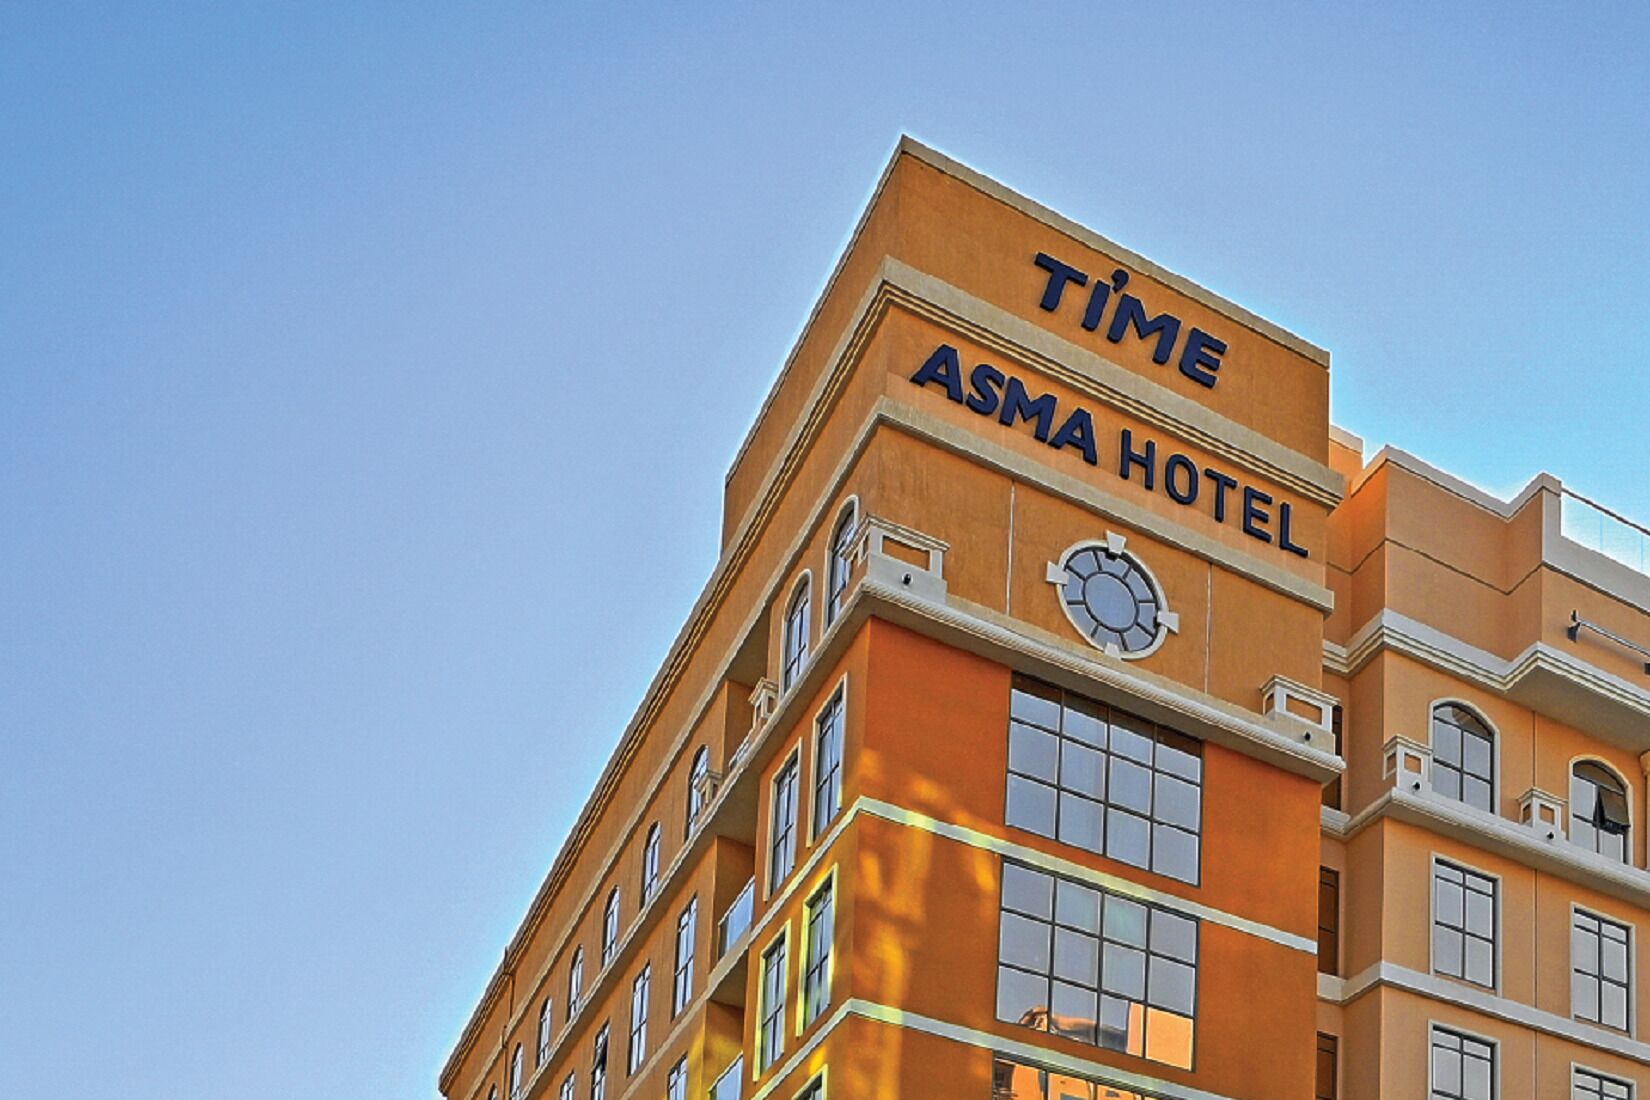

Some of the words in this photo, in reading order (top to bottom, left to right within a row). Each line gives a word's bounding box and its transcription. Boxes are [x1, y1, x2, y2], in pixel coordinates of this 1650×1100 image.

[1033, 251, 1229, 389] TIME
[908, 343, 1099, 466] ASMA
[1118, 428, 1310, 559] HOTEL
